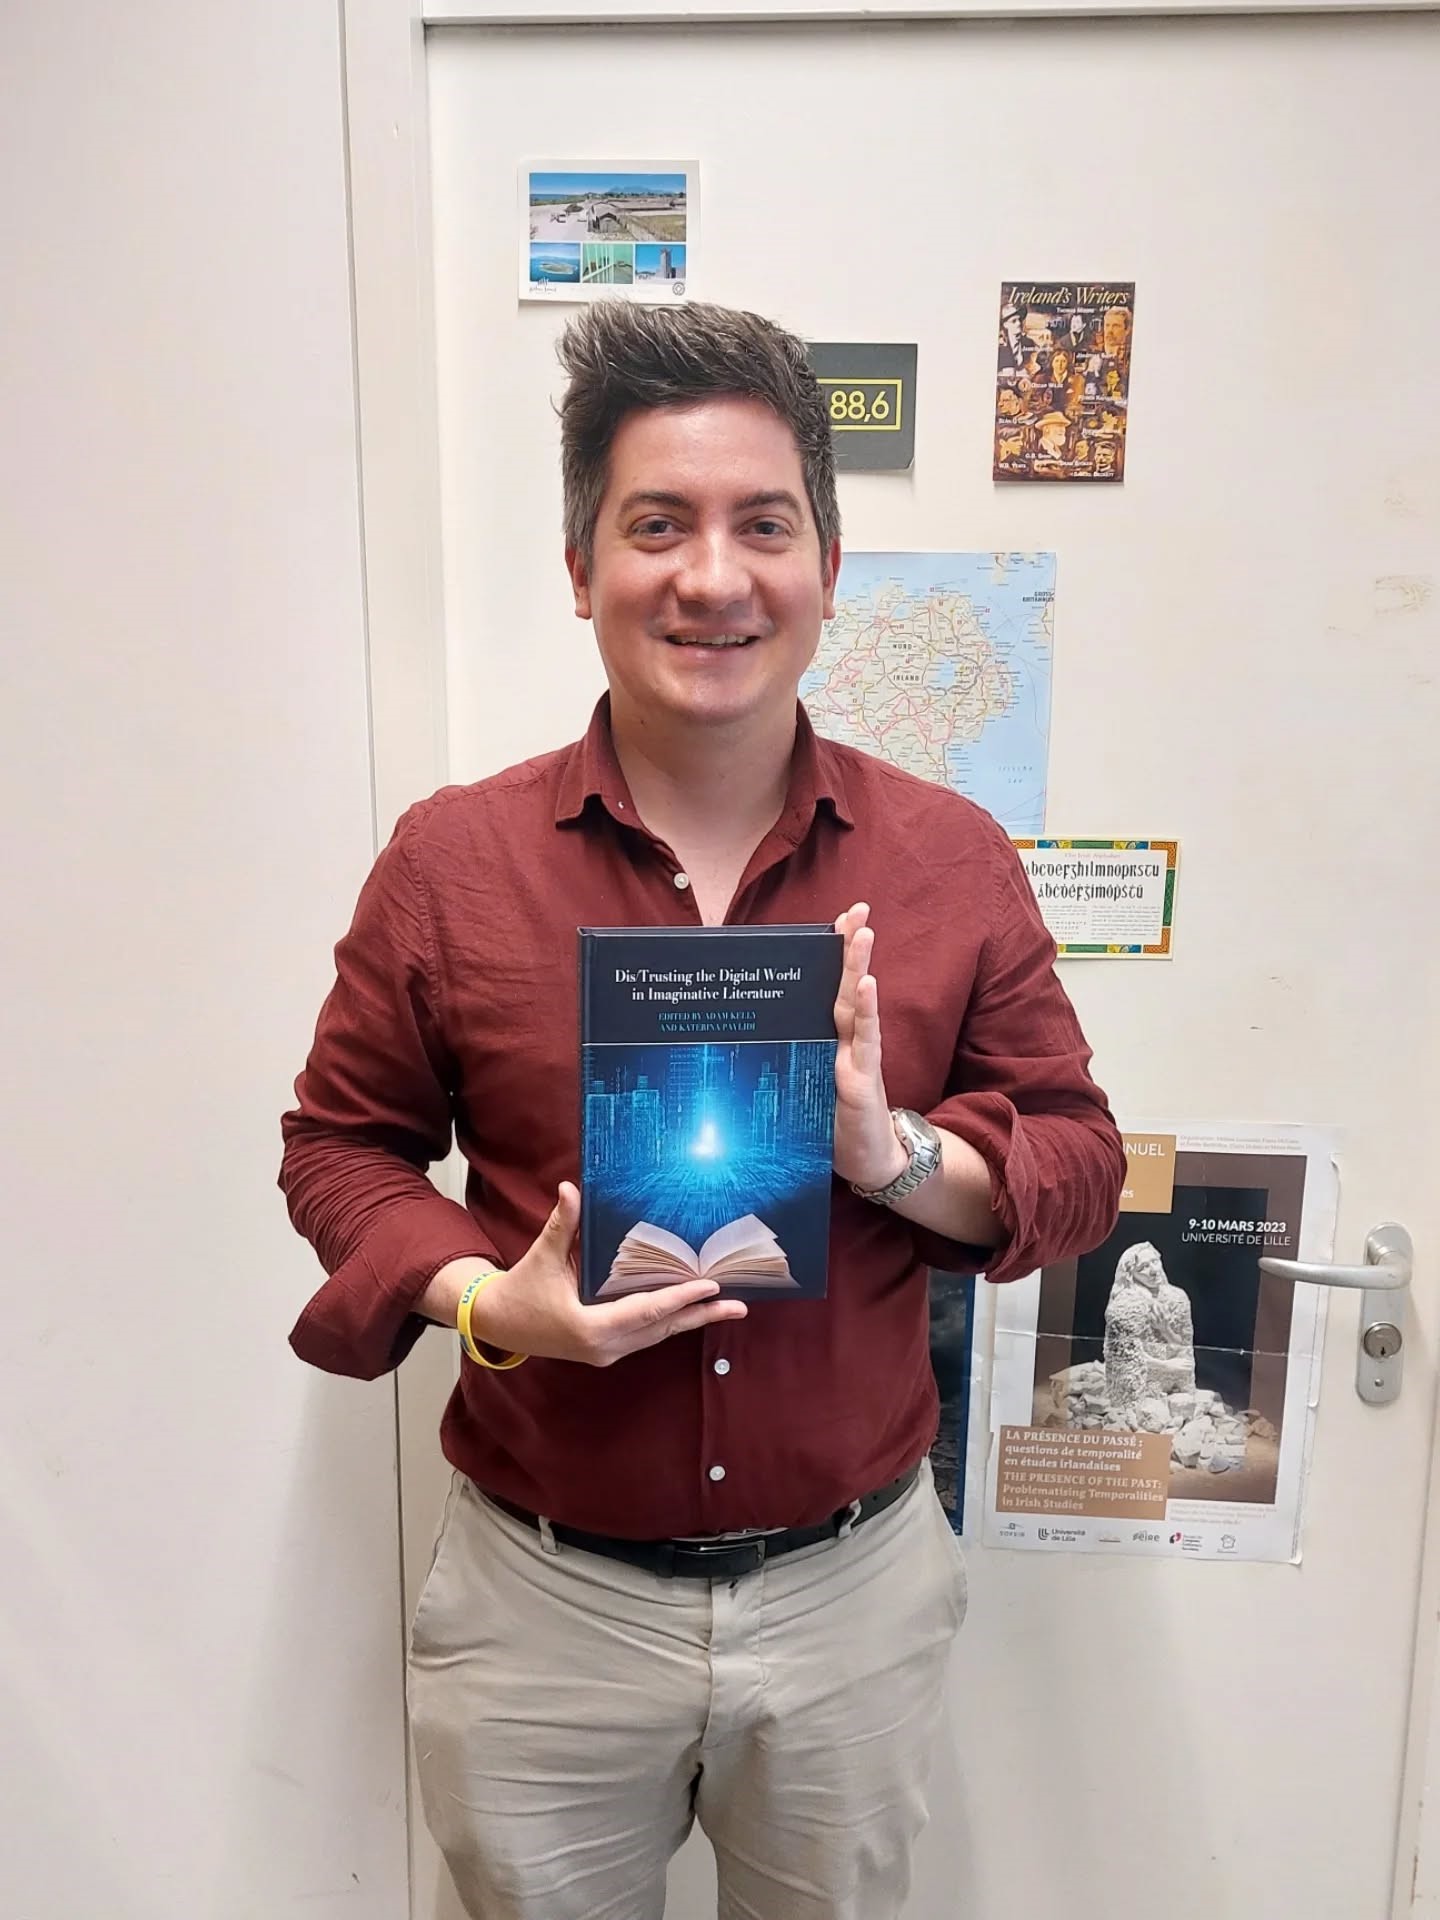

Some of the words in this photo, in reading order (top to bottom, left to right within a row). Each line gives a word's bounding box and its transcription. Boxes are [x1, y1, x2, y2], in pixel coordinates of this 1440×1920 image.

[1008, 286, 1072, 305] Ireland's
[1076, 286, 1129, 305] Writers
[830, 391, 890, 422] 88,6
[615, 968, 694, 986] Dis/Trusting
[696, 968, 716, 983] the
[719, 967, 760, 986] Digital
[763, 967, 801, 982] World
[632, 987, 645, 1001] in
[648, 987, 720, 1005] Imaginative
[723, 987, 785, 1000] Literature
[658, 1012, 690, 1021] EDITED
[692, 1012, 702, 1021] BY
[704, 1011, 729, 1020] ADAM
[730, 1011, 757, 1020] KELLY
[660, 1023, 678, 1032] AND
[679, 1023, 721, 1032] KATERINA
[1123, 1142, 1166, 1157] NUEL
[1188, 1218, 1216, 1231] 9-10
[1217, 1219, 1254, 1232] MARS
[1255, 1221, 1287, 1233] 2023
[1181, 1231, 1244, 1245] UNIVERSITÉ
[1246, 1234, 1262, 1245] DE
[1263, 1234, 1292, 1246] LILLE
[1006, 1430, 1021, 1441] LA
[1024, 1429, 1081, 1444] PRÉSENCE
[1083, 1434, 1100, 1445] DU
[1102, 1433, 1137, 1447] PASSÉ
[1005, 1443, 1059, 1456] questions
[1061, 1446, 1074, 1457] de
[1077, 1447, 1142, 1461] temporalité
[1004, 1458, 1018, 1466] en
[1020, 1456, 1057, 1468] études
[1059, 1459, 1121, 1472] irlandaises
[1003, 1471, 1027, 1482] THE
[1028, 1473, 1086, 1485] PRESENCE
[1088, 1476, 1102, 1486] OF
[1105, 1477, 1128, 1488] THE
[1130, 1478, 1162, 1489] PAST:
[1003, 1484, 1087, 1499] Problematising
[1088, 1488, 1164, 1502] Temporalities
[1002, 1496, 1014, 1506] in
[1015, 1497, 1042, 1508] Irish
[1043, 1498, 1084, 1510] Studies
[1051, 1528, 1086, 1536] Université
